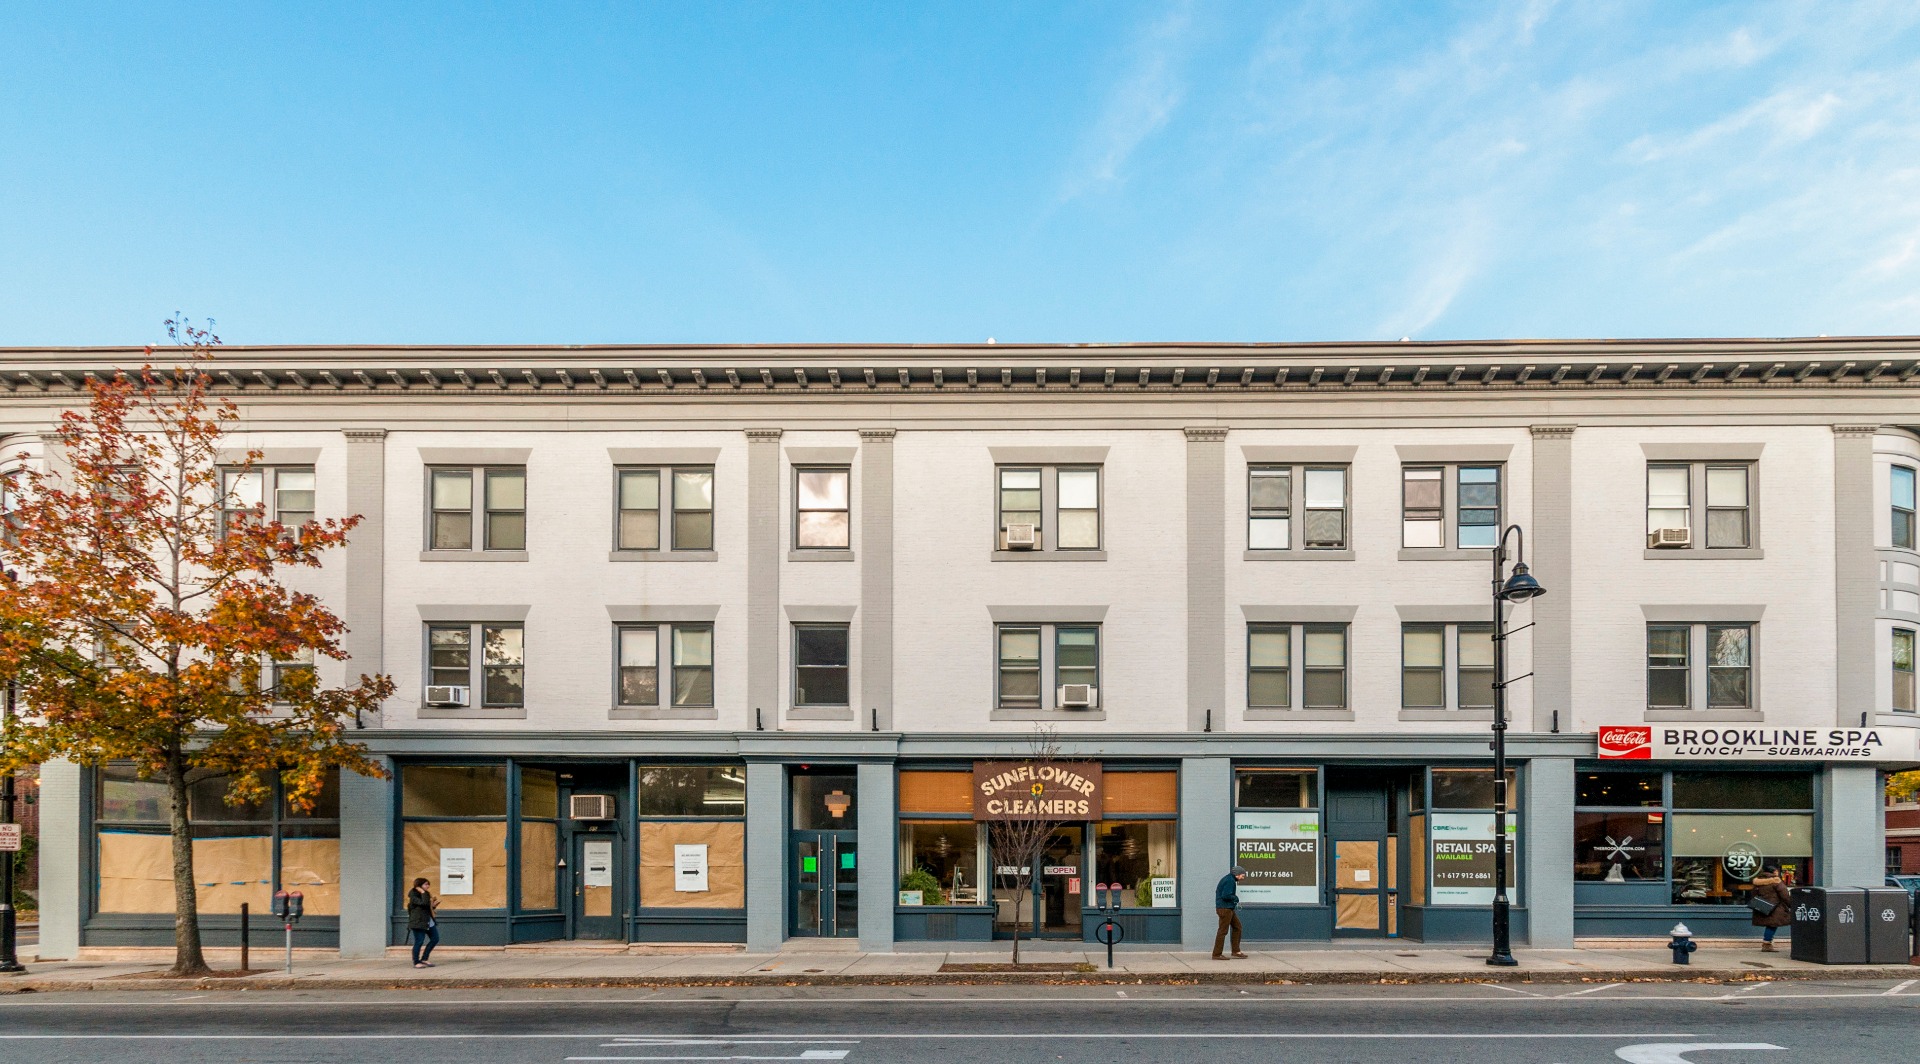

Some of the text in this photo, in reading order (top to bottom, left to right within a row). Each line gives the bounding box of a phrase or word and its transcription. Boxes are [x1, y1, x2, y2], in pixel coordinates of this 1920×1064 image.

[1602, 731, 1647, 744] Coca-Cola
[1664, 729, 1883, 746] BROOKLINE SPA
[1675, 747, 1871, 756] LUNCH SUBMARINES
[980, 765, 1096, 797] SUNFLOWER
[986, 799, 1089, 815] CLEANERS
[1240, 842, 1314, 852] RETAIL SPACE
[1436, 843, 1511, 853] RETAIL SPAE
[1727, 855, 1757, 867] SPA
